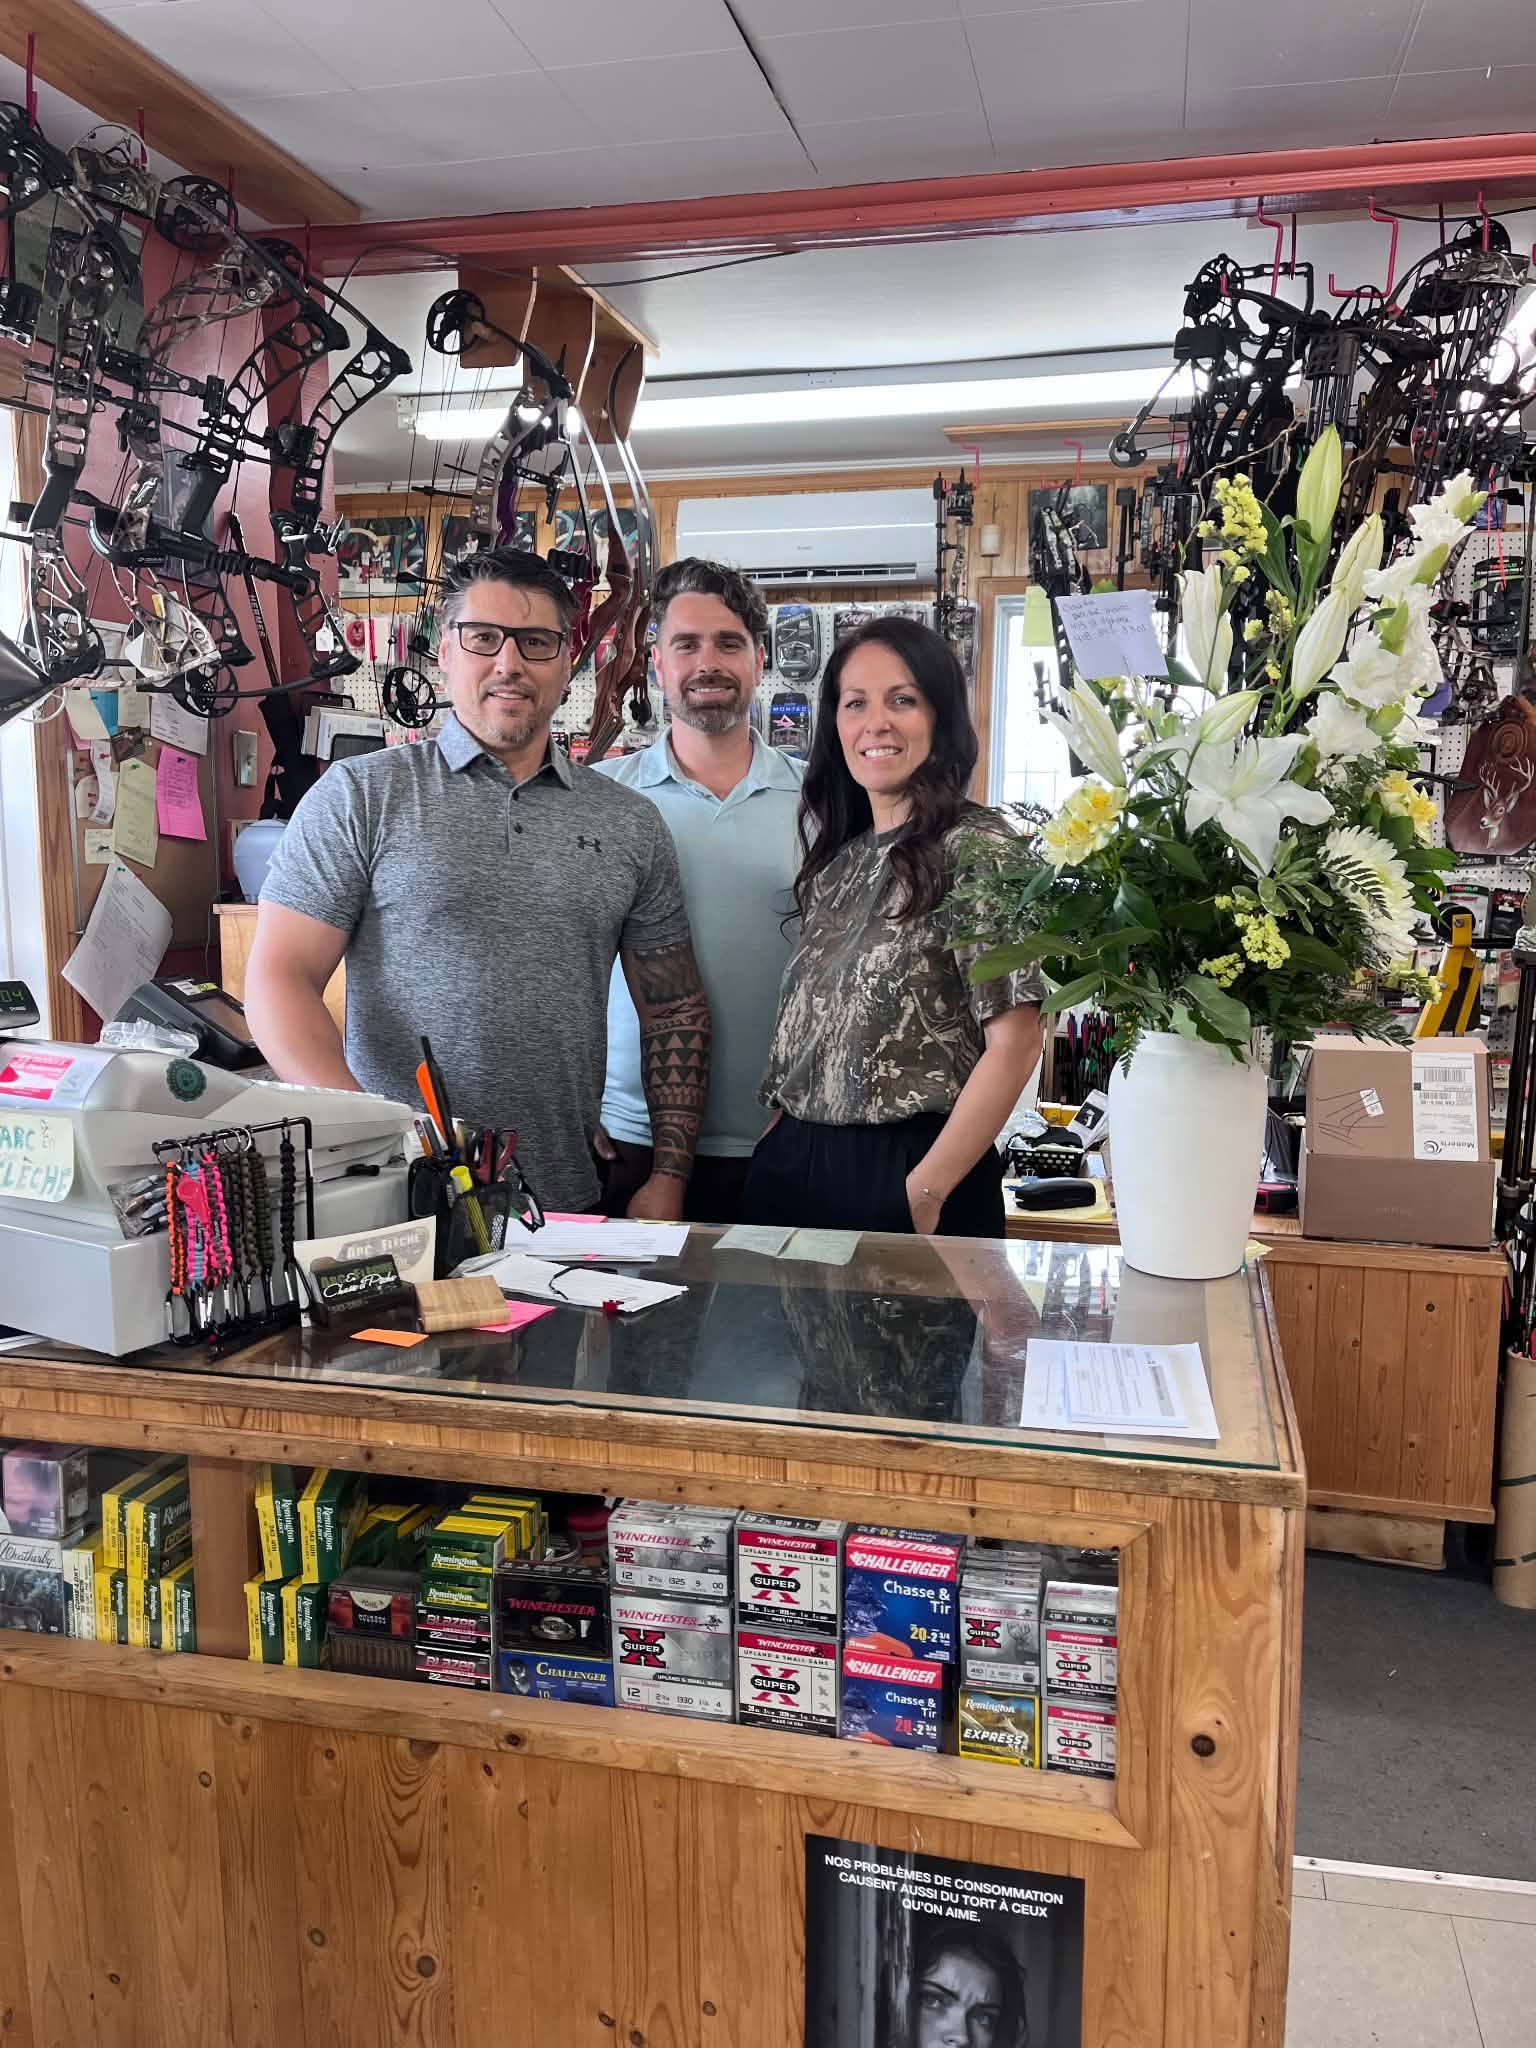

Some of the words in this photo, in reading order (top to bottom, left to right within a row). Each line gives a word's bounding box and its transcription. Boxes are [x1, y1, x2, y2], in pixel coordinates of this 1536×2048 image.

[282, 1498, 296, 1544] Remington
[322, 1506, 334, 1551] Remington
[612, 1530, 692, 1546] WINCHESTER
[756, 1536, 817, 1550] WINCHESTER
[0, 1537, 54, 1569] Weatherby
[433, 1552, 478, 1566] Remington
[853, 1553, 950, 1578] CHALLENGER
[622, 1571, 633, 1580] 12
[668, 1576, 686, 1586] 1325
[754, 1576, 796, 1590] SUPER
[428, 1588, 474, 1602] Remington
[883, 1580, 936, 1598] Chasse
[939, 1588, 950, 1601] &
[180, 1590, 192, 1633] Remington
[266, 1592, 276, 1636] Remington
[508, 1598, 596, 1617] WINCHESTER
[930, 1601, 952, 1615] Tir
[302, 1596, 313, 1641] Remington
[426, 1614, 477, 1629] BLAZER
[616, 1608, 699, 1626] WINCHESTER
[429, 1631, 441, 1640] 22
[968, 1628, 999, 1638] SUPER
[624, 1640, 660, 1654] SUPER
[756, 1639, 816, 1653] WINCHESTER
[426, 1656, 476, 1671] BLAZER
[850, 1659, 936, 1683] CHALLENGER
[1058, 1662, 1089, 1672] SUPER
[428, 1672, 441, 1681] 22
[536, 1662, 607, 1682] CHALLENGER
[754, 1678, 796, 1692] SUPER
[627, 1688, 641, 1698] 12
[676, 1696, 694, 1705] 1330
[885, 1692, 925, 1707] Chasse
[927, 1698, 936, 1709] &
[921, 1707, 937, 1719] Tir
[965, 1698, 1016, 1714] Remington
[963, 1728, 1024, 1746] EXPRESS
[1060, 1738, 1089, 1748] SUPER
[824, 1854, 852, 1870] NOS
[854, 1860, 932, 1884] PROBLÈMES
[934, 1874, 952, 1888] DE
[954, 1878, 1064, 1905] CONSOMMATION
[839, 1872, 898, 1892] CAUSENT
[900, 1884, 938, 1901] AUSSI
[940, 1890, 960, 1904] DU
[962, 1895, 996, 1910] TORT
[999, 1895, 1010, 1912] À
[1011, 1903, 1048, 1918] CEUX
[902, 1898, 943, 1916] QU'ON
[945, 1907, 981, 1924] AIME.
